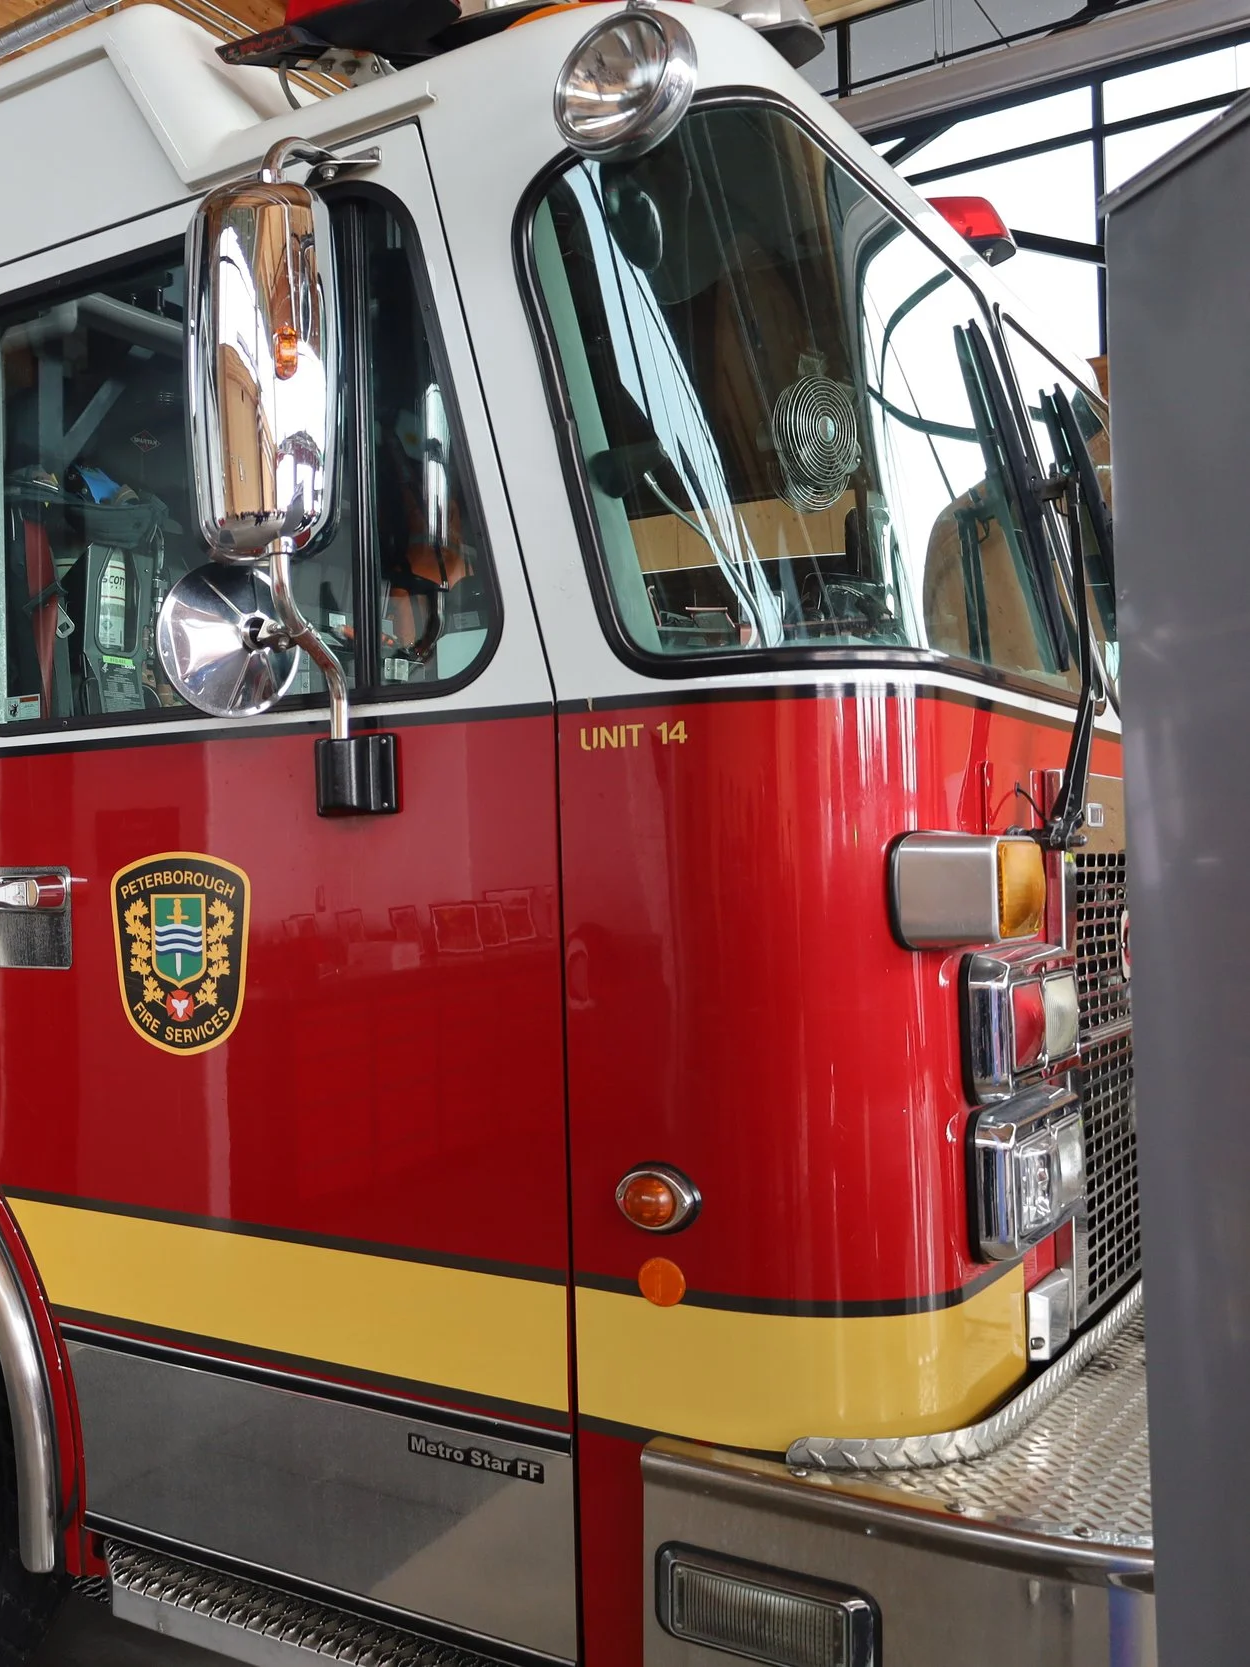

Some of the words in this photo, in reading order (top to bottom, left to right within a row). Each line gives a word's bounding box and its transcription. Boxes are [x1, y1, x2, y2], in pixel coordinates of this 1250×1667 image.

[580, 723, 644, 751] UNIT
[656, 720, 688, 745] 14
[120, 870, 236, 899] PETERBOROUGH
[133, 1001, 161, 1034] FIRE
[164, 1006, 230, 1043] SERVICES
[410, 1436, 465, 1462] Metro
[470, 1450, 511, 1473] Star
[516, 1460, 541, 1479] FF
